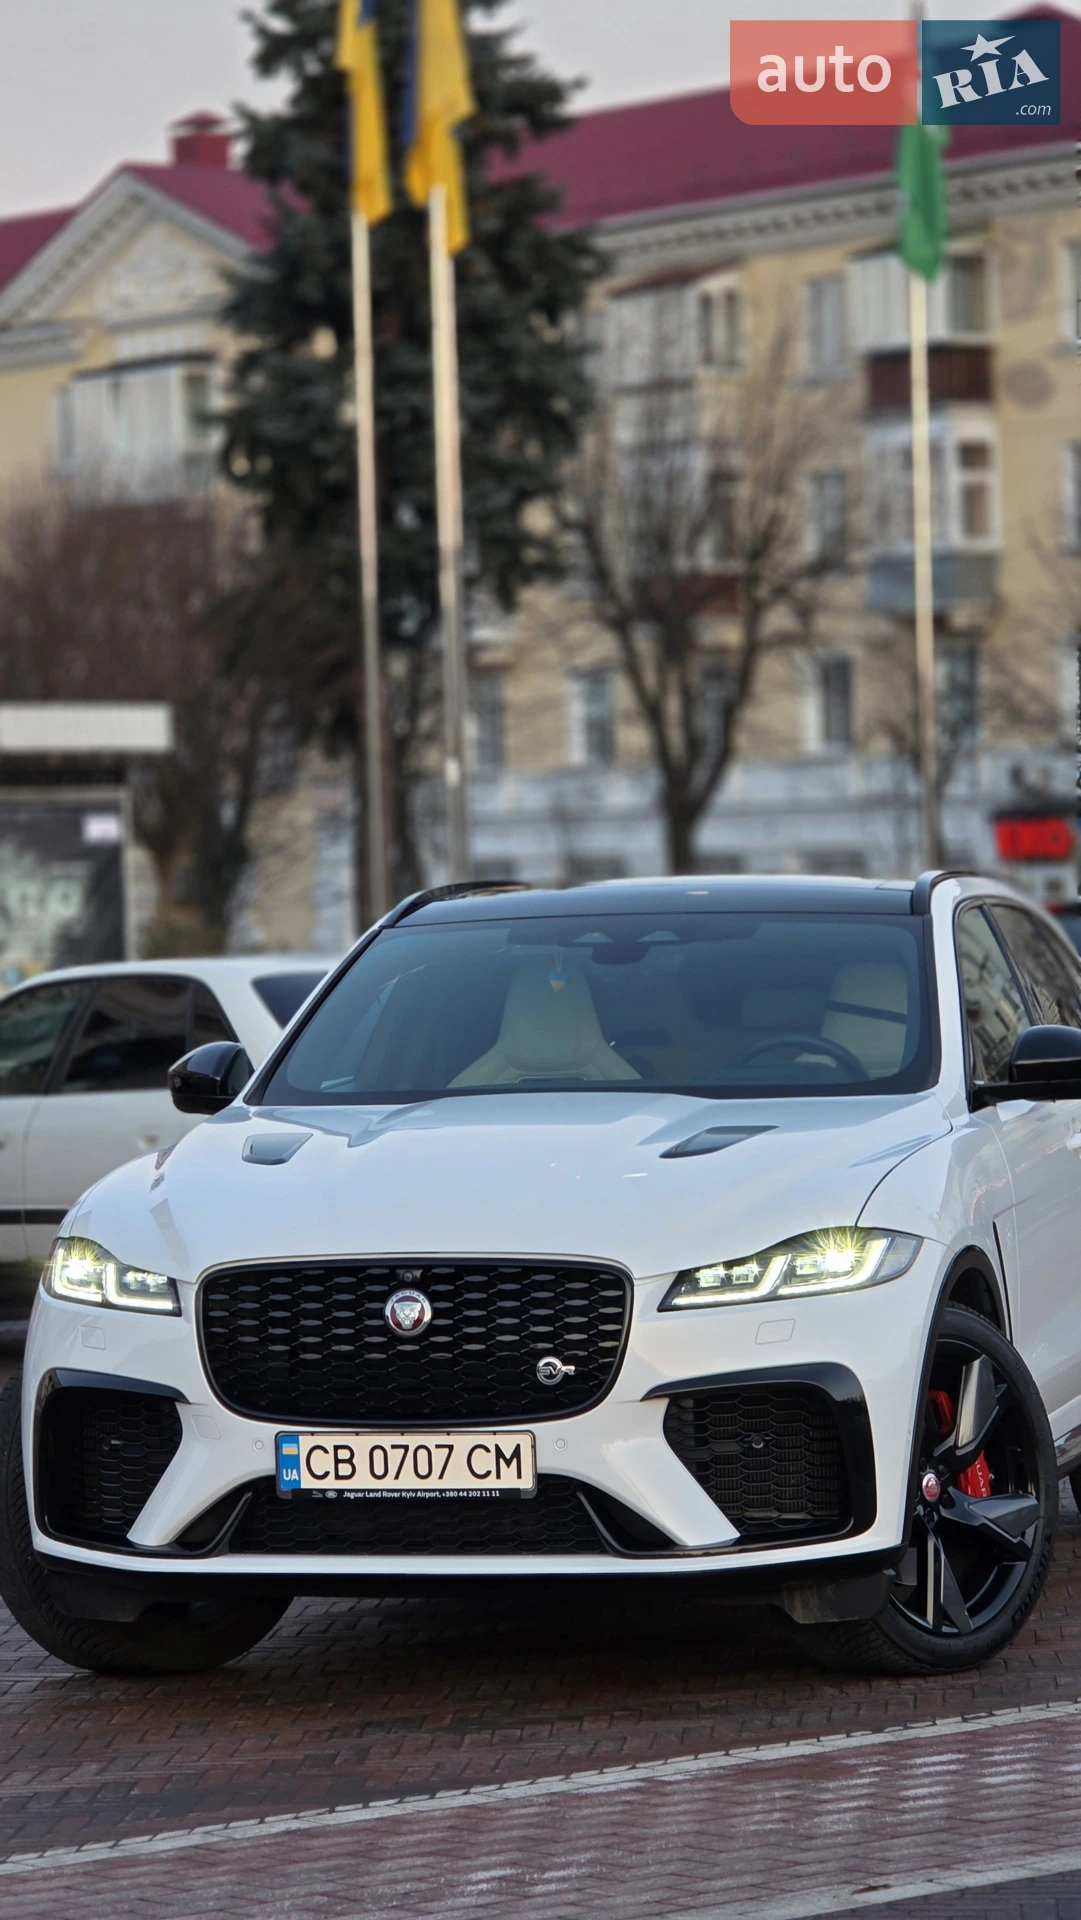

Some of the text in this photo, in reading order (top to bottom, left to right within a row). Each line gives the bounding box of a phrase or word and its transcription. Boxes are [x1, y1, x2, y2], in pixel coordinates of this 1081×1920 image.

[390, 1290, 427, 1304] JAGUAR
[305, 1443, 523, 1481] CB 0707 CM
[282, 1468, 299, 1482] UA
[343, 1490, 365, 1500] Jaguar
[365, 1490, 382, 1498] Land
[382, 1490, 401, 1498] Rover
[401, 1490, 416, 1500] Kyiv
[416, 1490, 441, 1500] Airport,
[441, 1490, 458, 1498] +380
[458, 1490, 467, 1498] 44
[468, 1490, 481, 1498] 202
